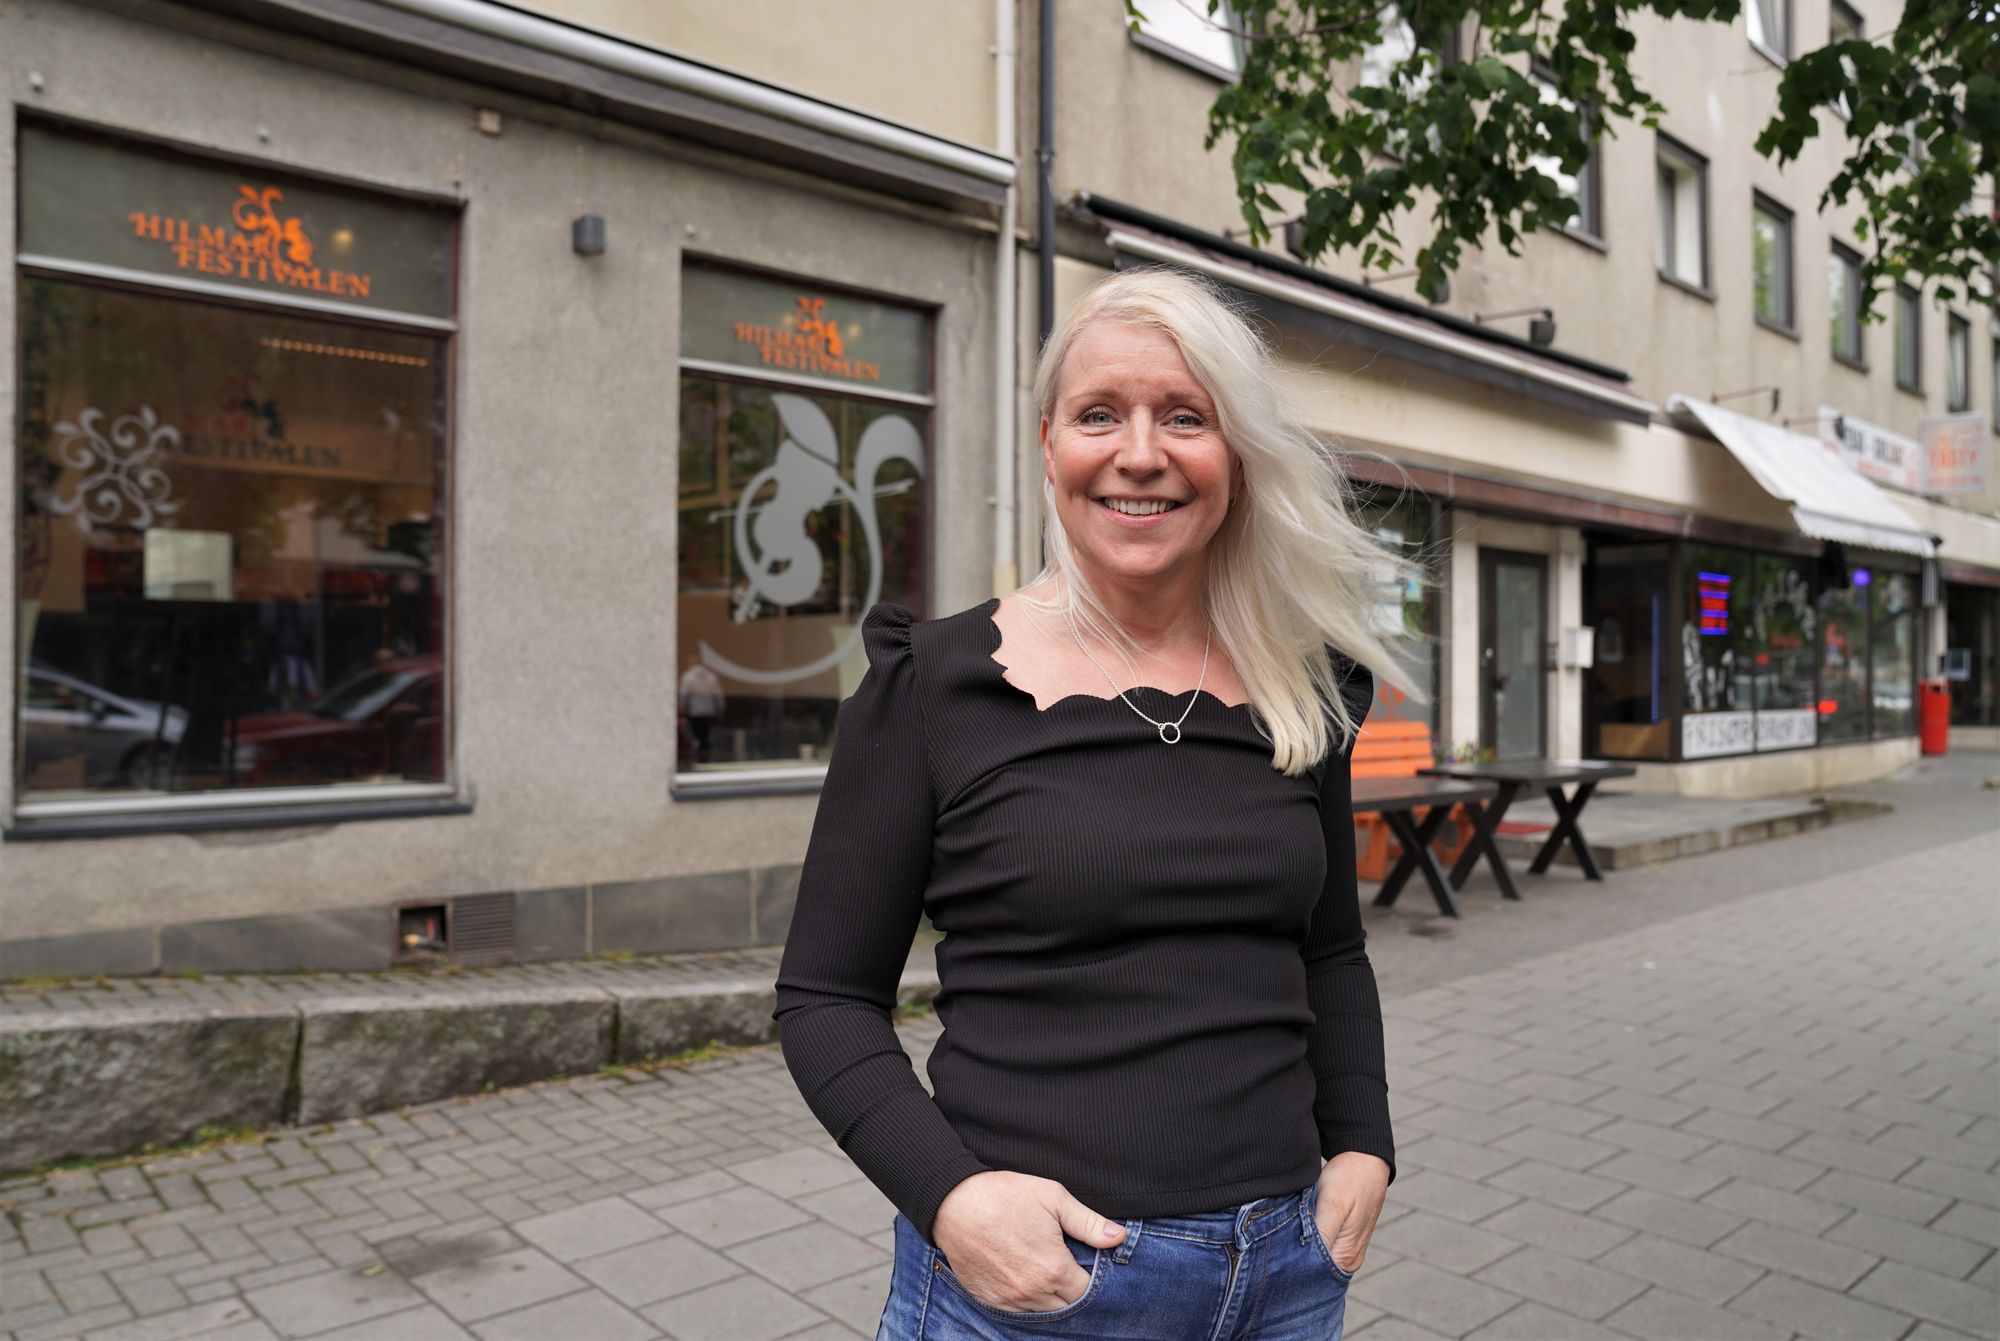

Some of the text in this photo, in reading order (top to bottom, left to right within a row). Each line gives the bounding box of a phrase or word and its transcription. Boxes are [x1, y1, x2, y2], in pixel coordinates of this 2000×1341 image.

[128, 211, 270, 259] HILMAR
[171, 239, 371, 298] FESTIVALEN
[732, 321, 819, 350] HILMAR
[760, 342, 880, 381] FESTIVALEN
[172, 429, 342, 468] ESTIVALEN
